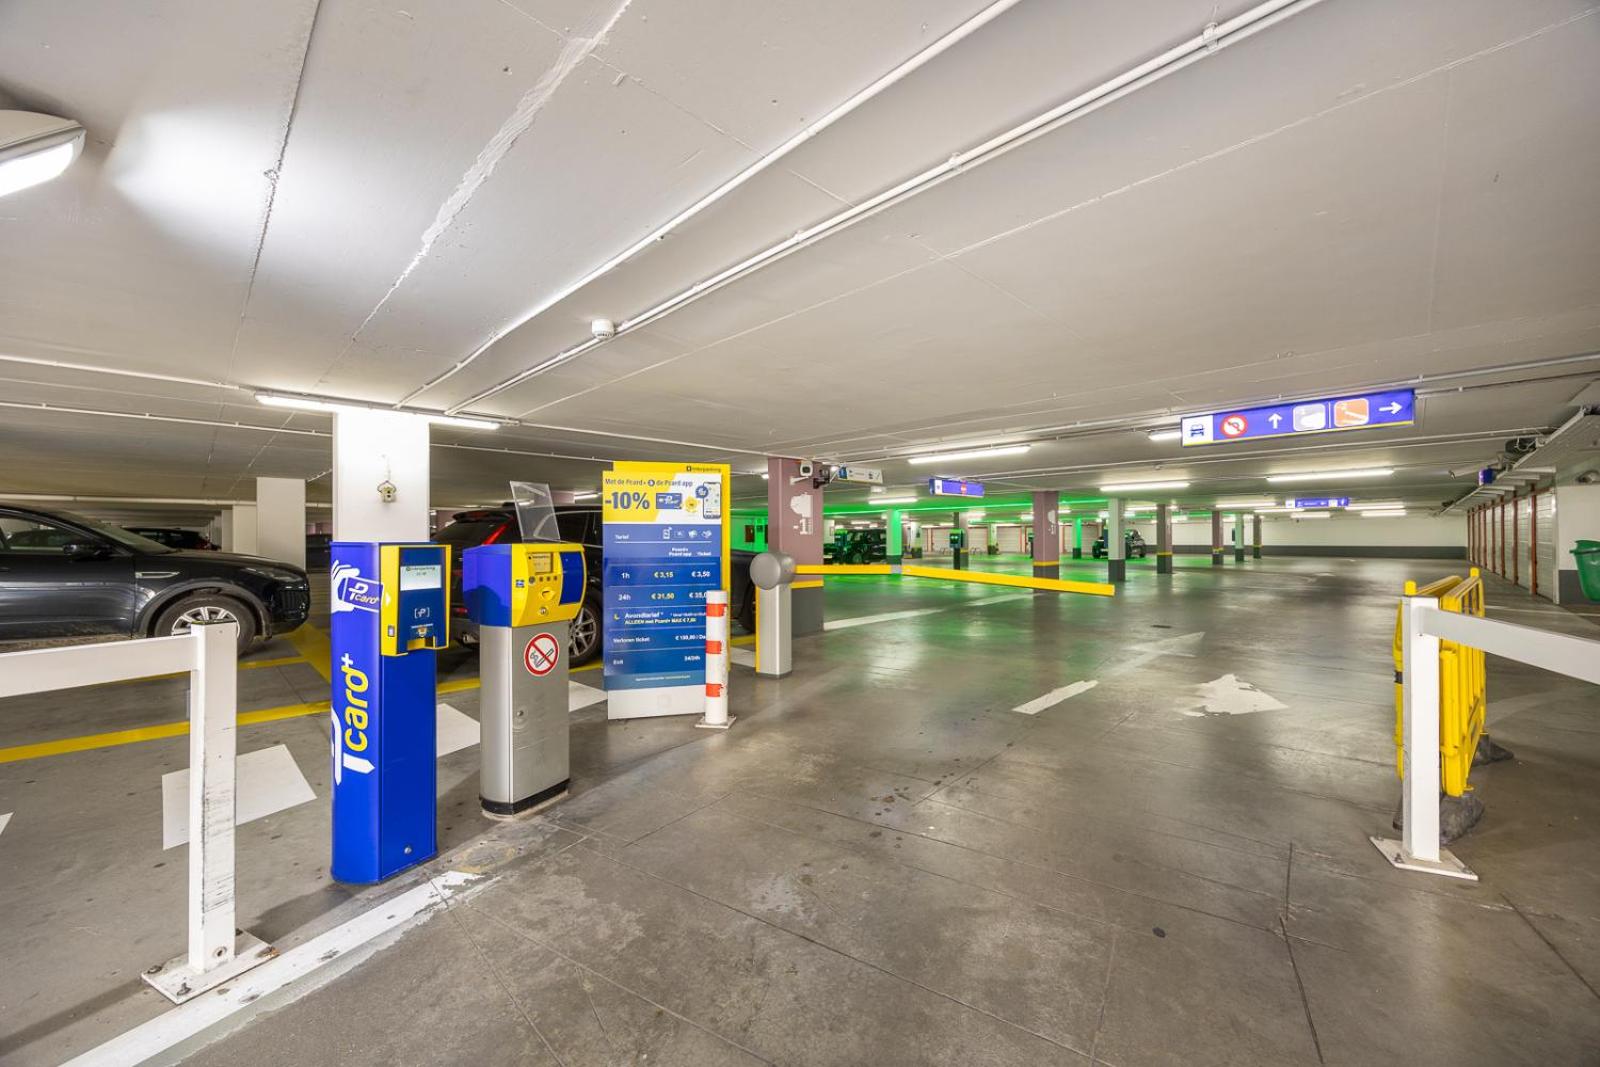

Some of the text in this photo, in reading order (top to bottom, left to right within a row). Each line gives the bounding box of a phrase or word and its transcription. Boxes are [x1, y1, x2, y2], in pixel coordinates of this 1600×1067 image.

[664, 479, 681, 487] Pcard
[682, 480, 693, 488] app
[605, 493, 650, 509] -10%
